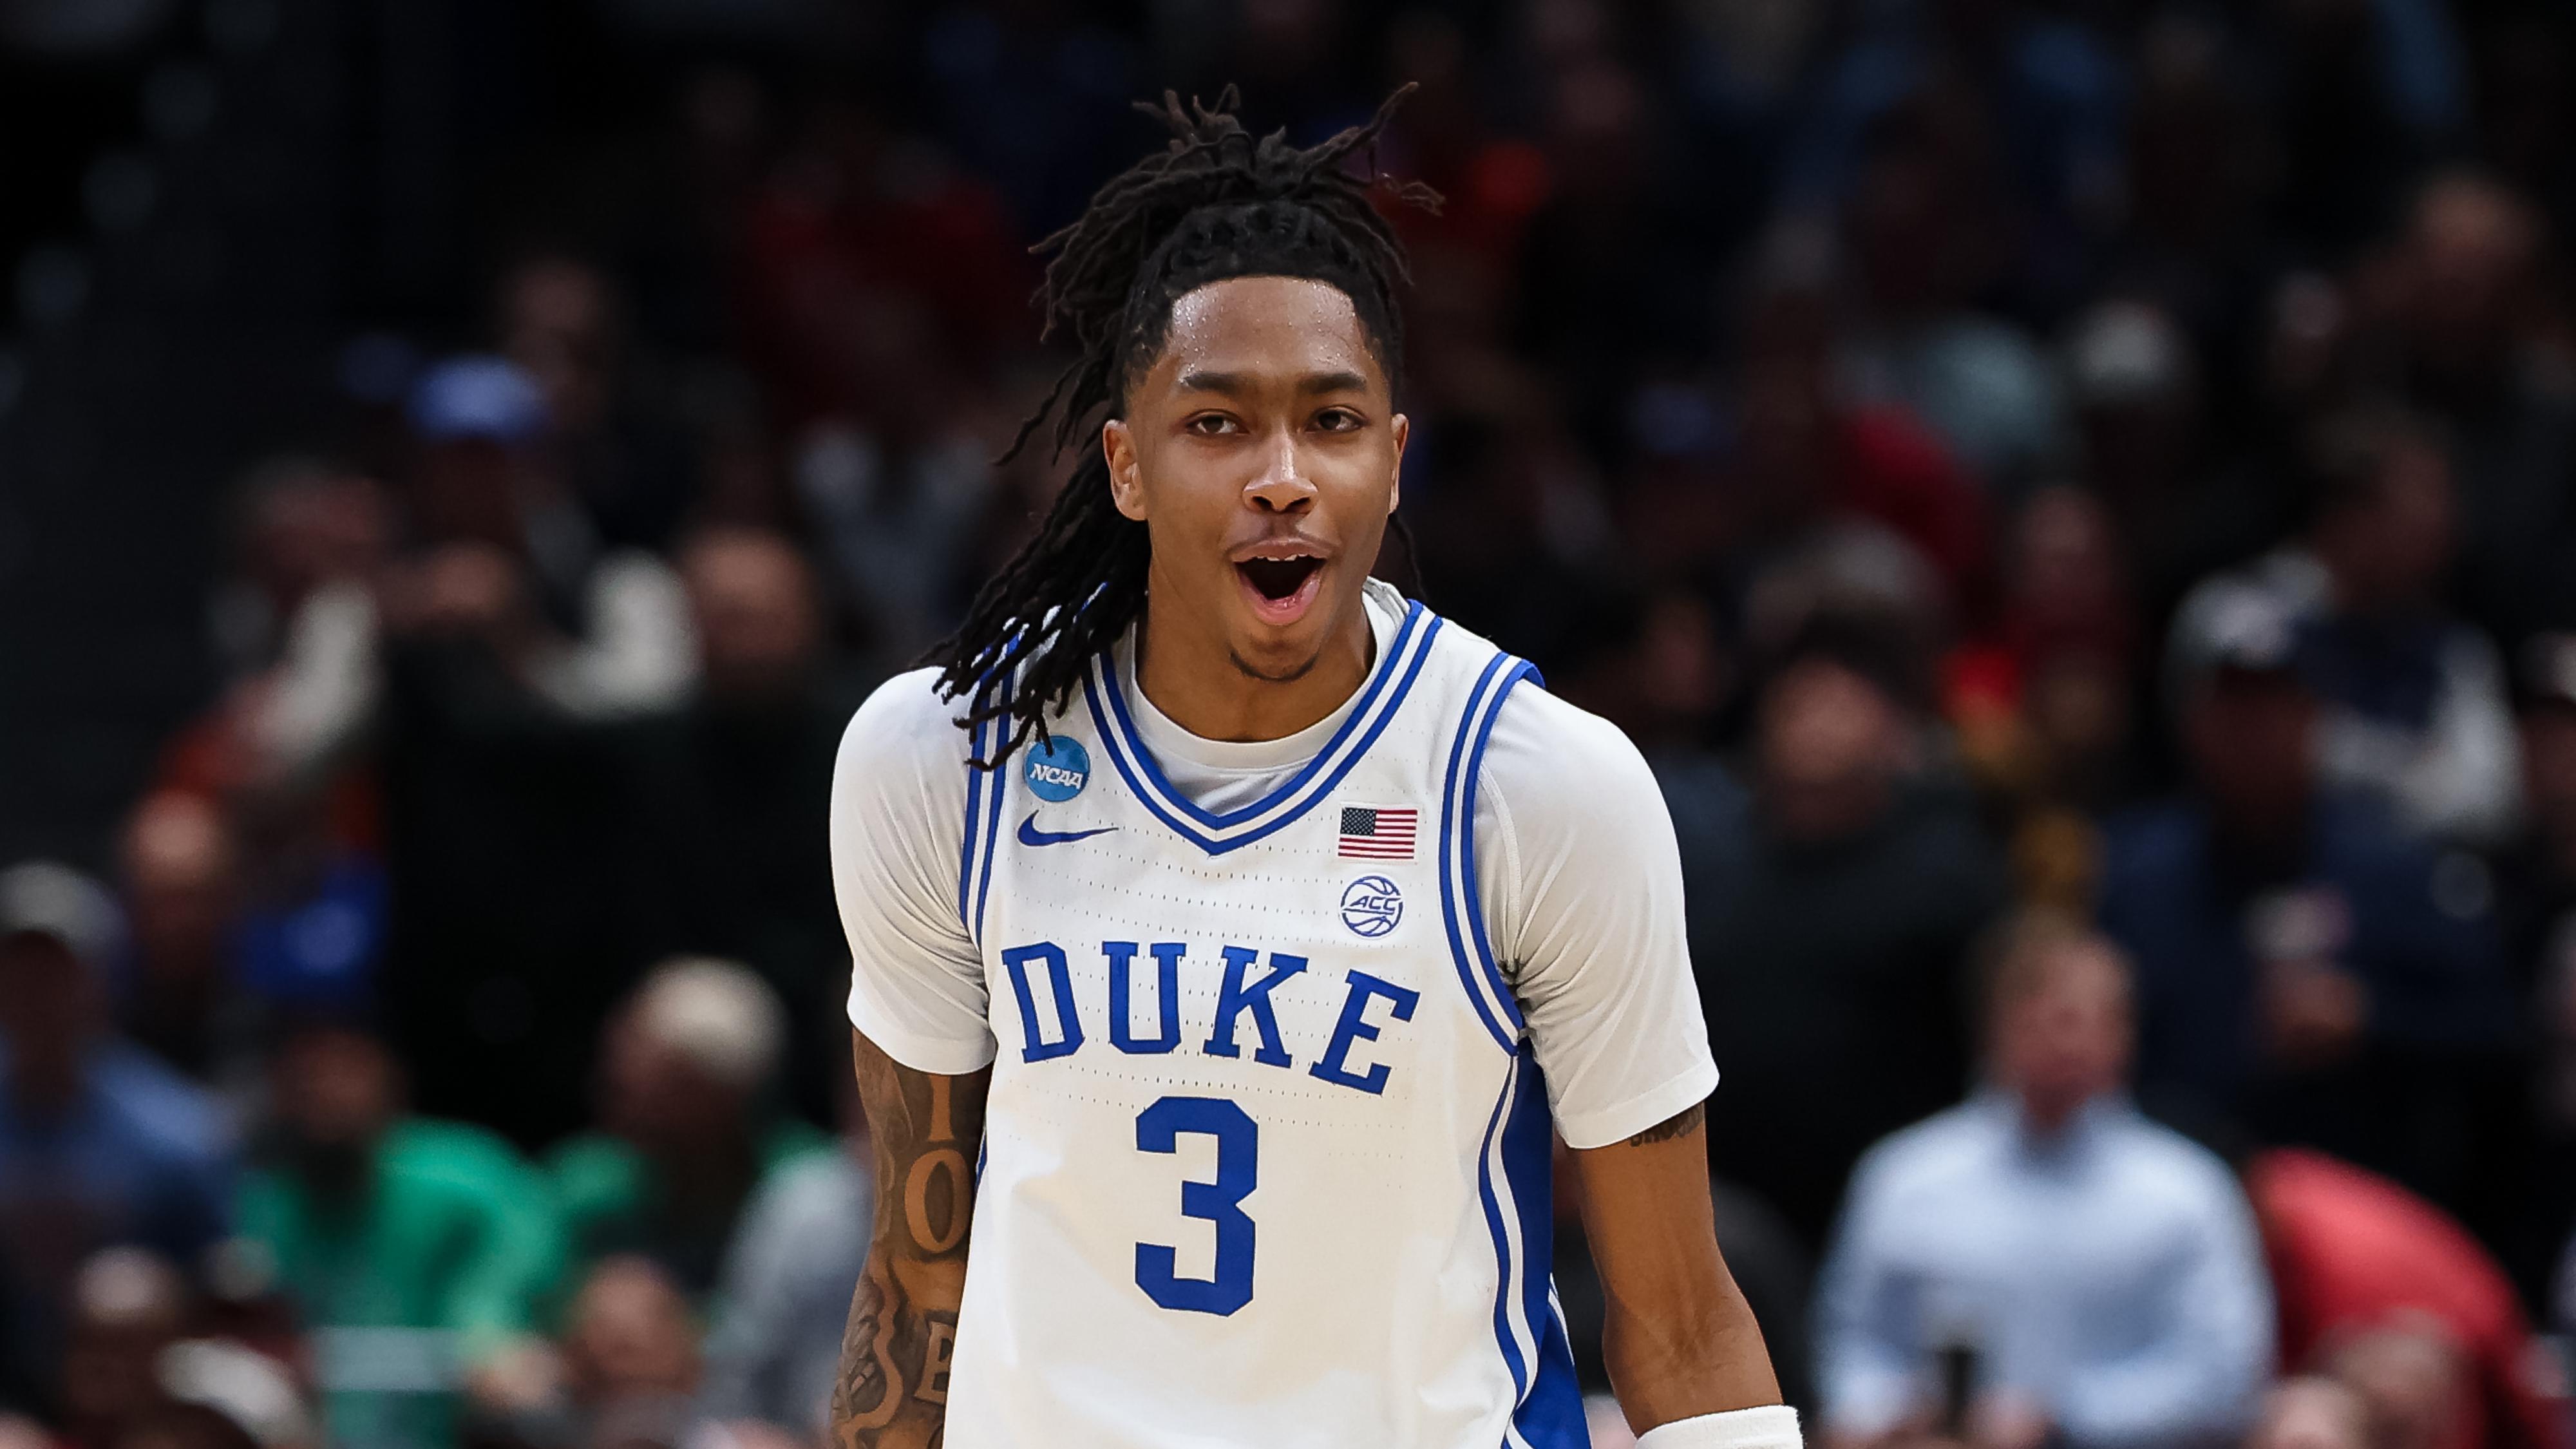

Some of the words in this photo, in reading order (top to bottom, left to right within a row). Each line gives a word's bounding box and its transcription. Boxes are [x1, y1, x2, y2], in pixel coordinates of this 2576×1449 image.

[1030, 762, 1083, 790] NCAA
[1349, 895, 1401, 912] ACC
[1001, 940, 1420, 1095] DUKE
[1135, 1096, 1258, 1317] 3
